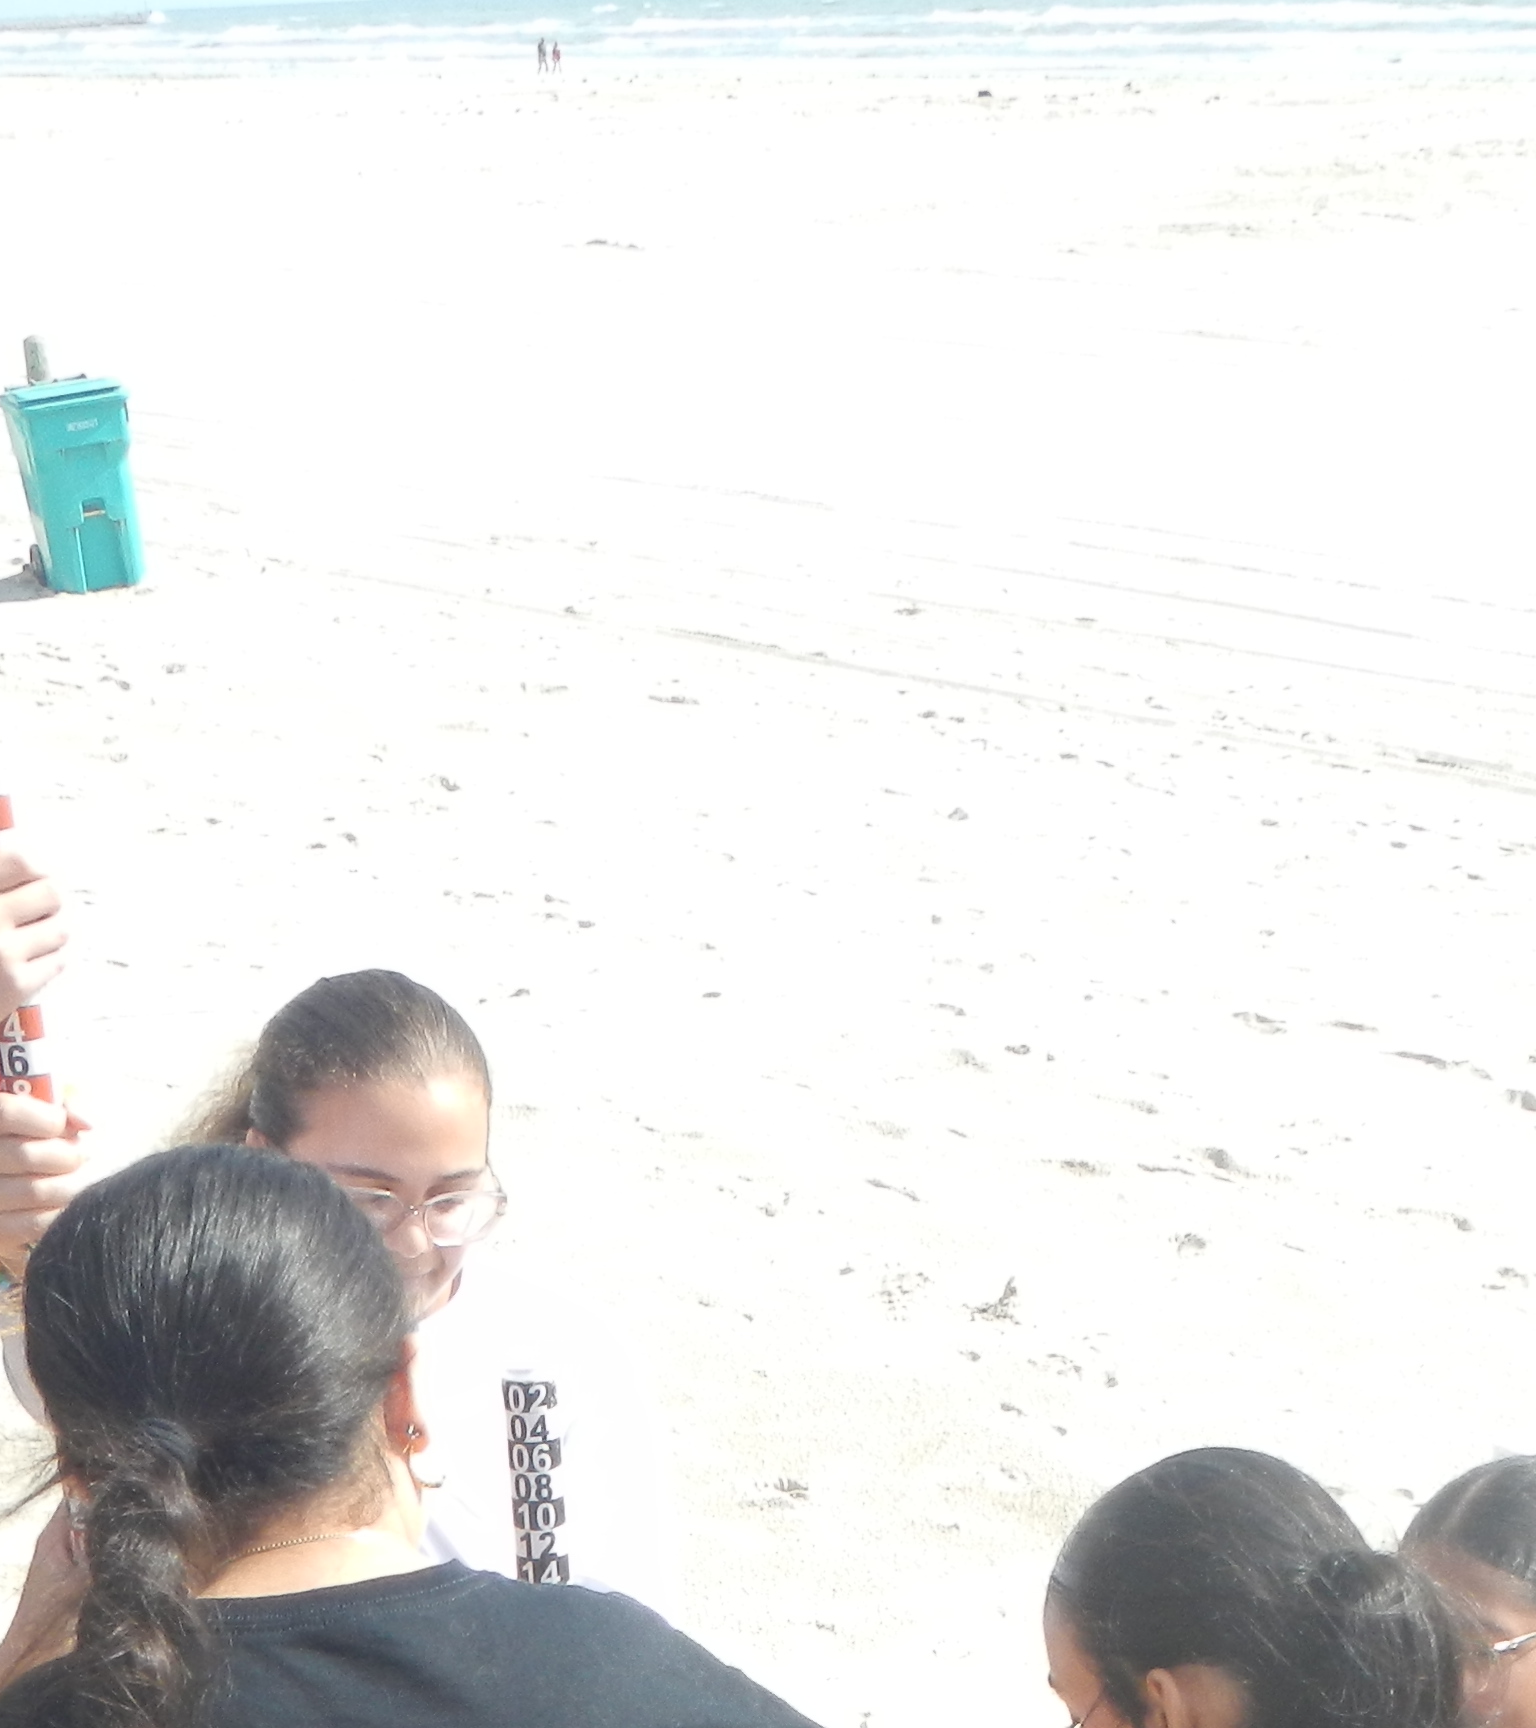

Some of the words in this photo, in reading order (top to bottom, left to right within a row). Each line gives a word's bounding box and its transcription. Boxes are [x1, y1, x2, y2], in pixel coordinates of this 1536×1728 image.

[508, 1385, 548, 1413] 02
[510, 1414, 550, 1442] 04
[512, 1444, 552, 1472] 06
[514, 1474, 553, 1501] 08
[517, 1503, 557, 1531] 10
[519, 1532, 557, 1560] 12
[521, 1560, 562, 1585] 14
